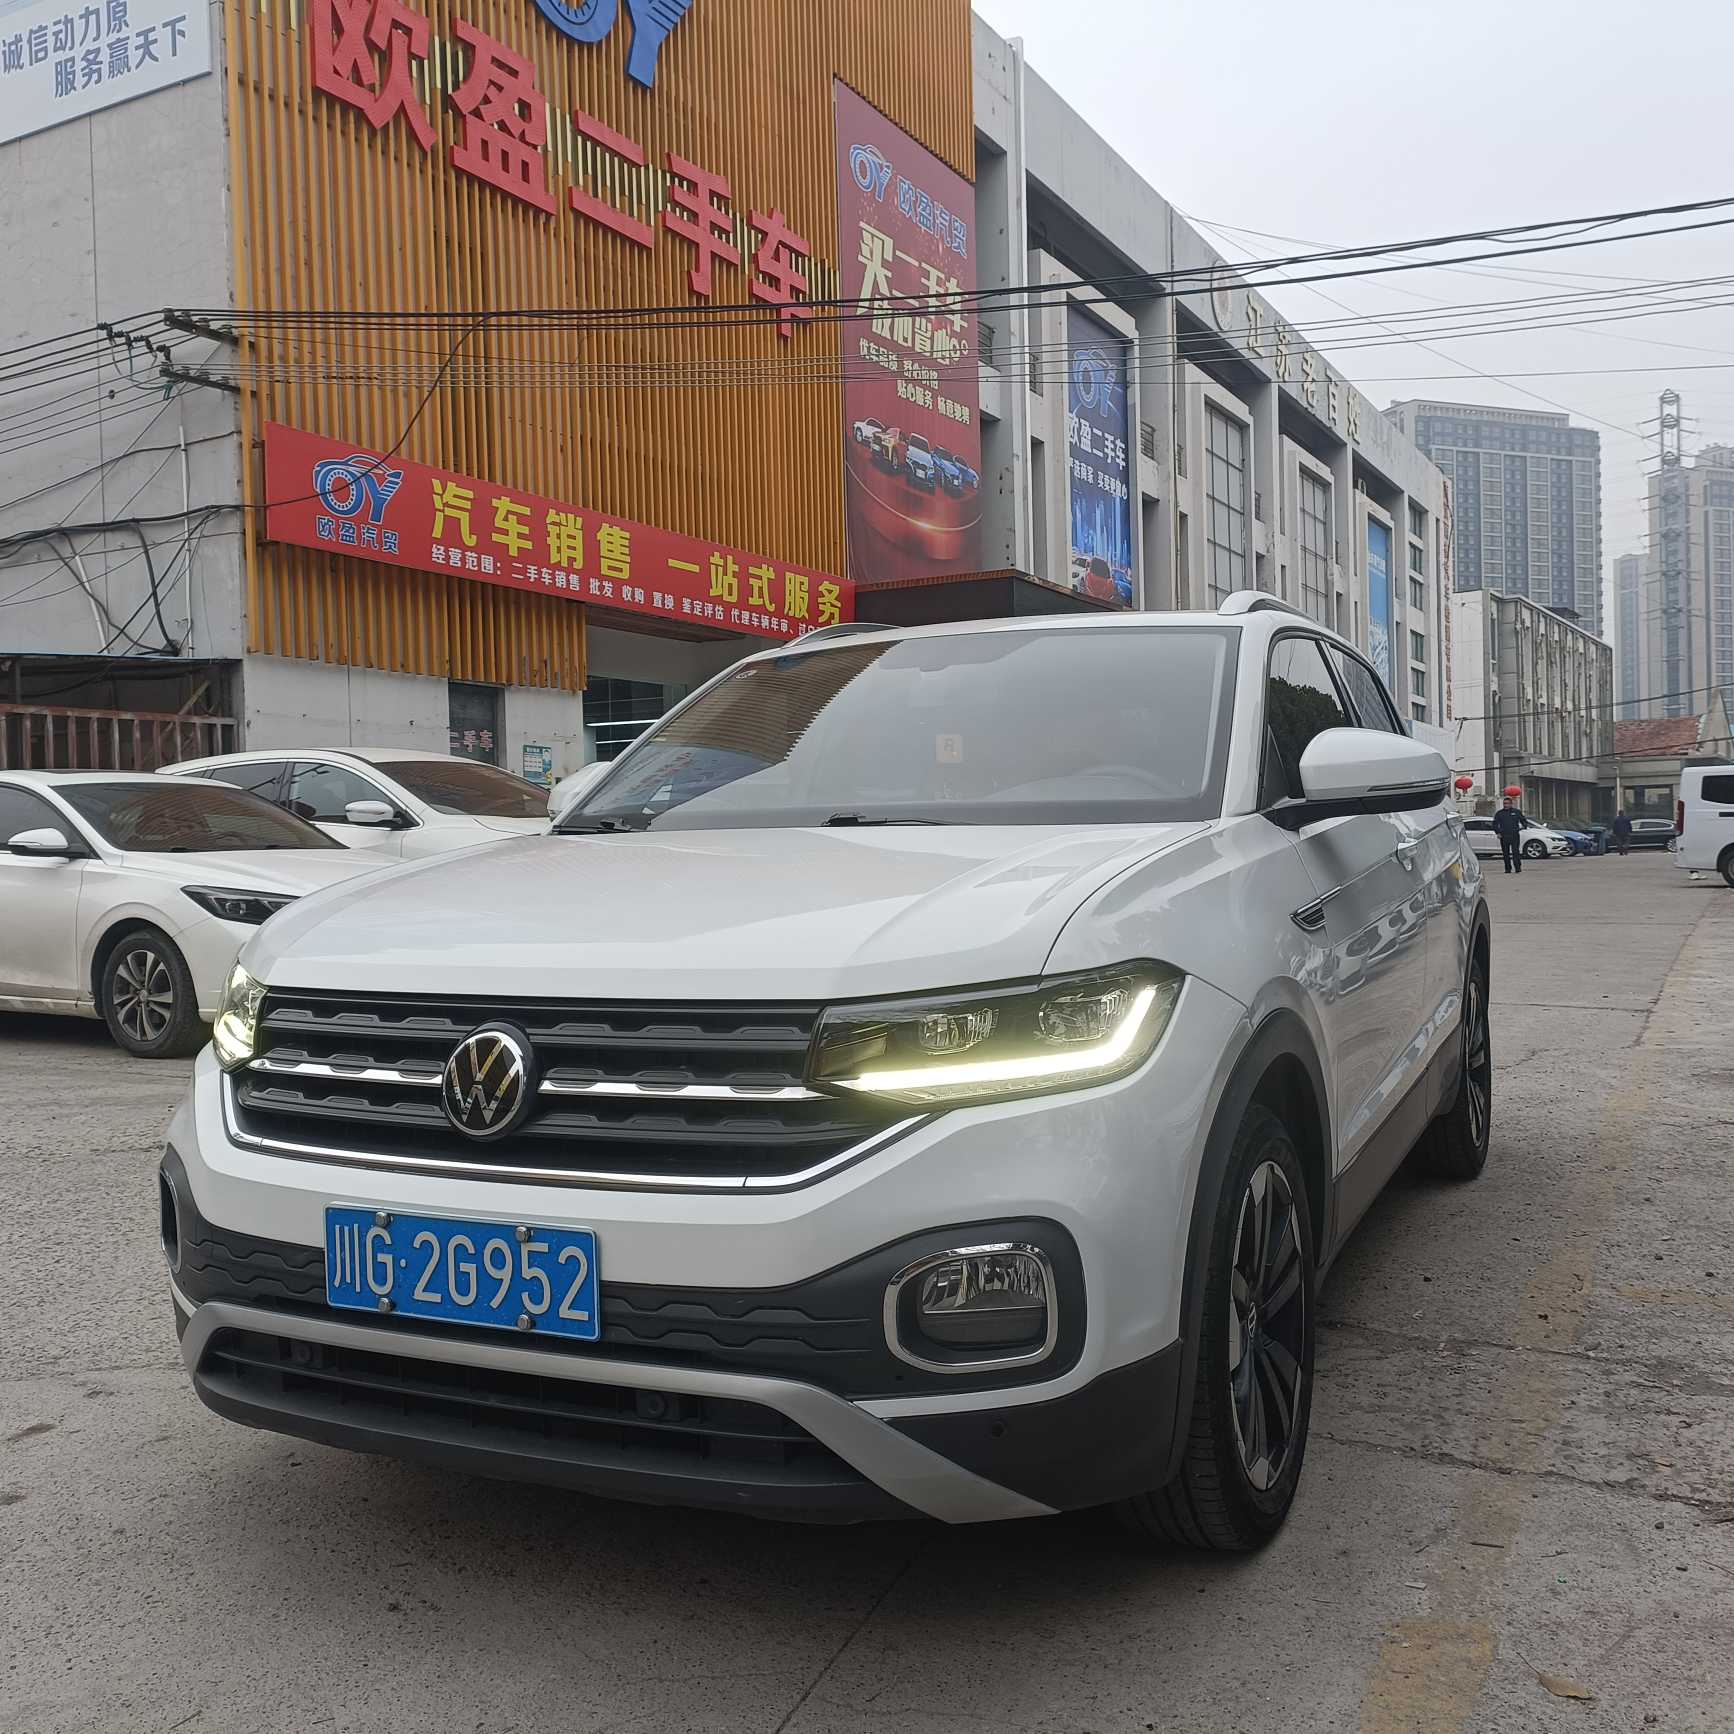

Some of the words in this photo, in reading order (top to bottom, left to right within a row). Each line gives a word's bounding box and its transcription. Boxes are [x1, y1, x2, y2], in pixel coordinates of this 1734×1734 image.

[54, 15, 187, 99] 服务赢天下
[311, 0, 811, 338] 欧盈二手车
[897, 175, 967, 258] 欧盈汽贸
[316, 515, 400, 555] 欧盈汽贸
[432, 478, 631, 580] 汽车销售
[667, 552, 842, 625] 一站式服务
[590, 577, 614, 599] 批发
[622, 585, 645, 605] 收购
[652, 591, 675, 610] 置换
